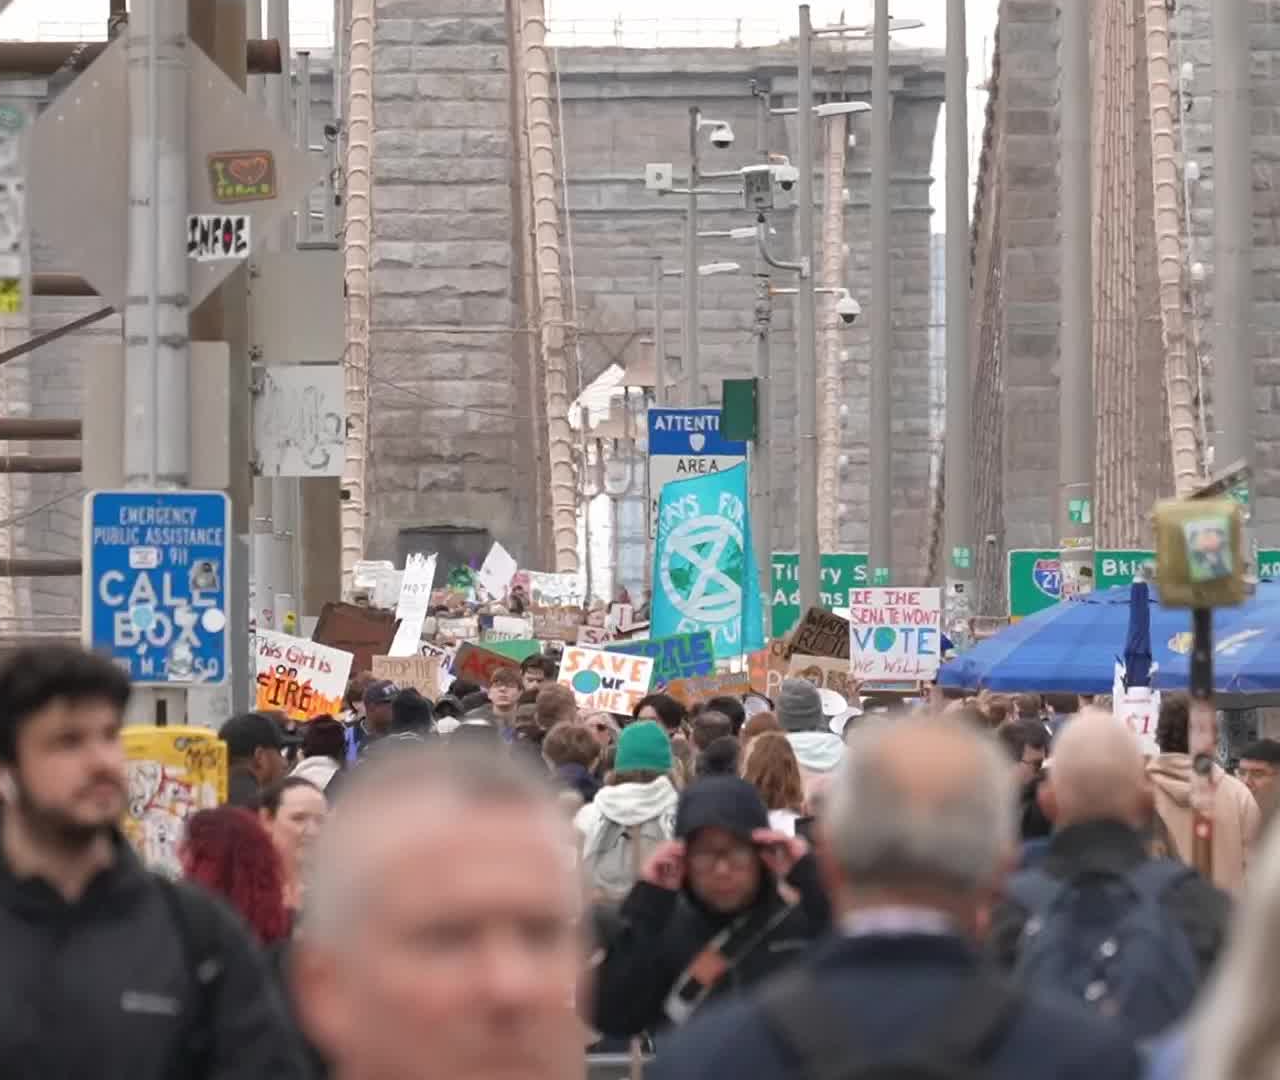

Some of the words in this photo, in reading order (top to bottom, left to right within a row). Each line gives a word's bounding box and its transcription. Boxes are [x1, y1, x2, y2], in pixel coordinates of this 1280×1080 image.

[655, 415, 720, 432] ATTENTI
[676, 459, 719, 473] AREA
[120, 506, 197, 525] EMERGENCY
[94, 527, 140, 545] PUBLIC
[146, 527, 224, 545] ASSISTANCE
[852, 591, 873, 606] IF
[884, 591, 921, 606] THE
[850, 607, 898, 625] SENATE
[286, 644, 316, 670] Girl
[565, 650, 648, 683] SAVE
